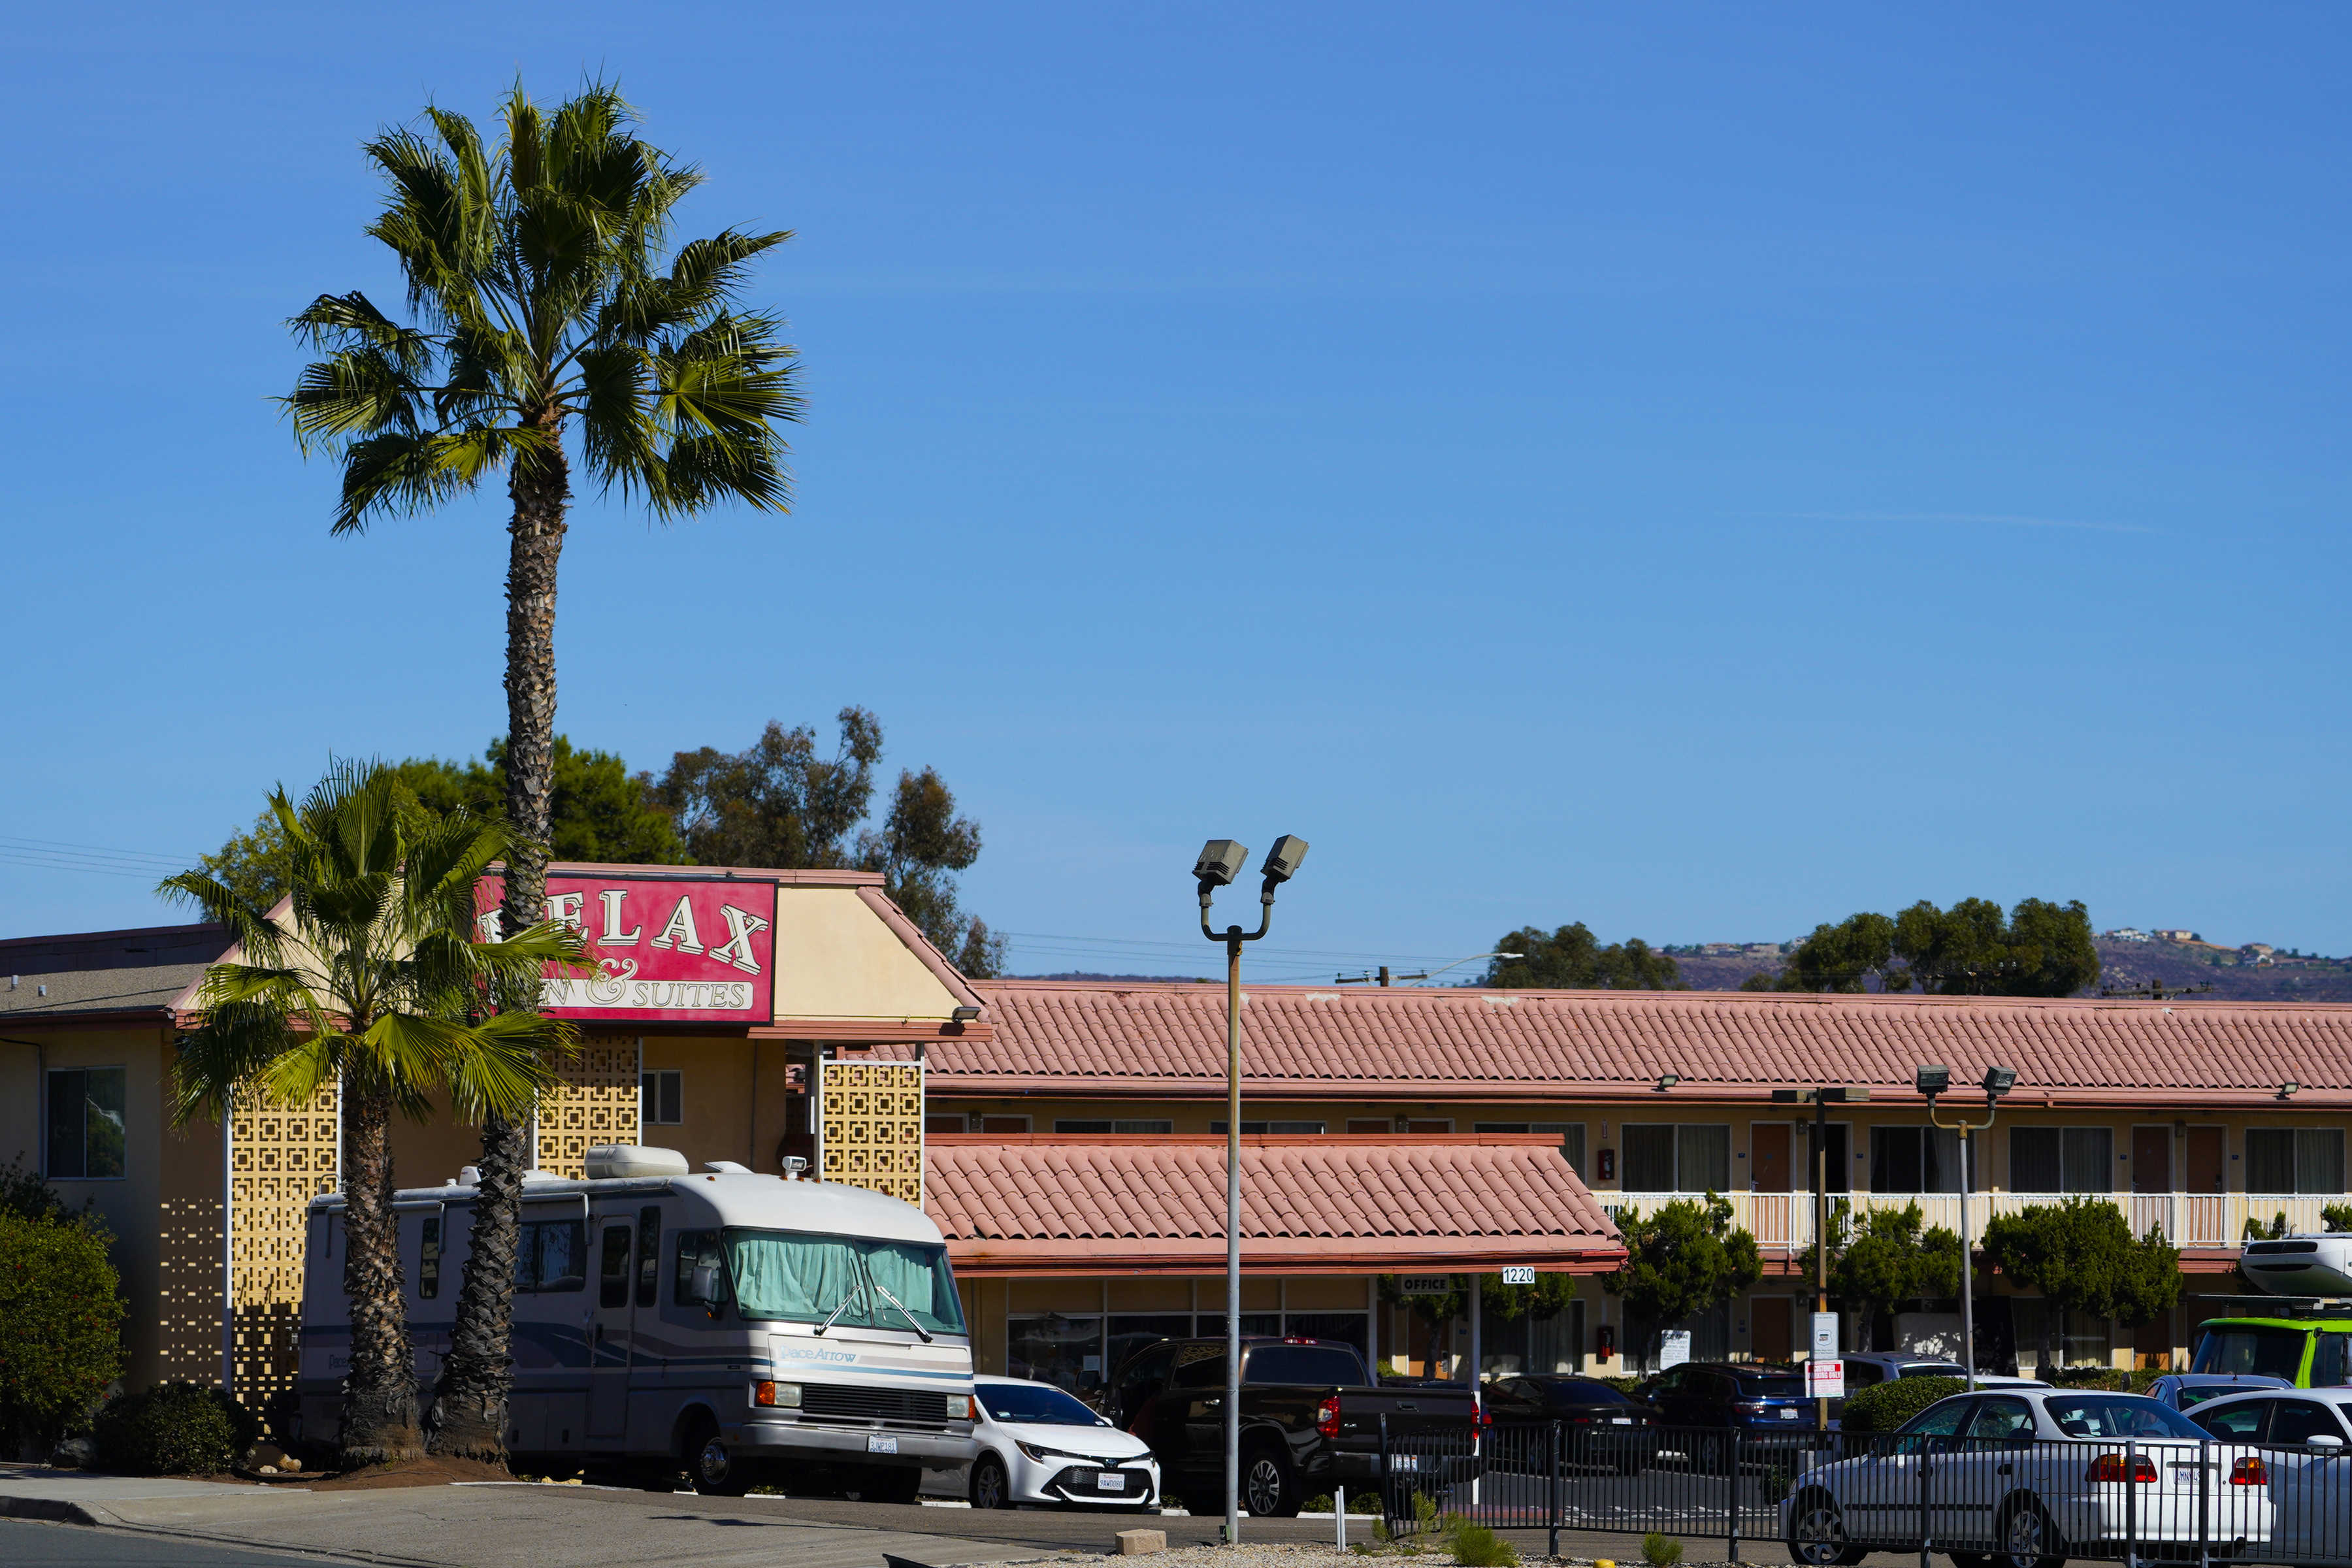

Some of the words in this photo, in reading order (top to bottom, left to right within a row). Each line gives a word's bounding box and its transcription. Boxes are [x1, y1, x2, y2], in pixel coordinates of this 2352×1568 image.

[632, 982, 745, 1007] SUITES
[1504, 1268, 1533, 1282] 1220
[1405, 1279, 1446, 1290] OFFICE
[813, 1348, 857, 1363] Arrow
